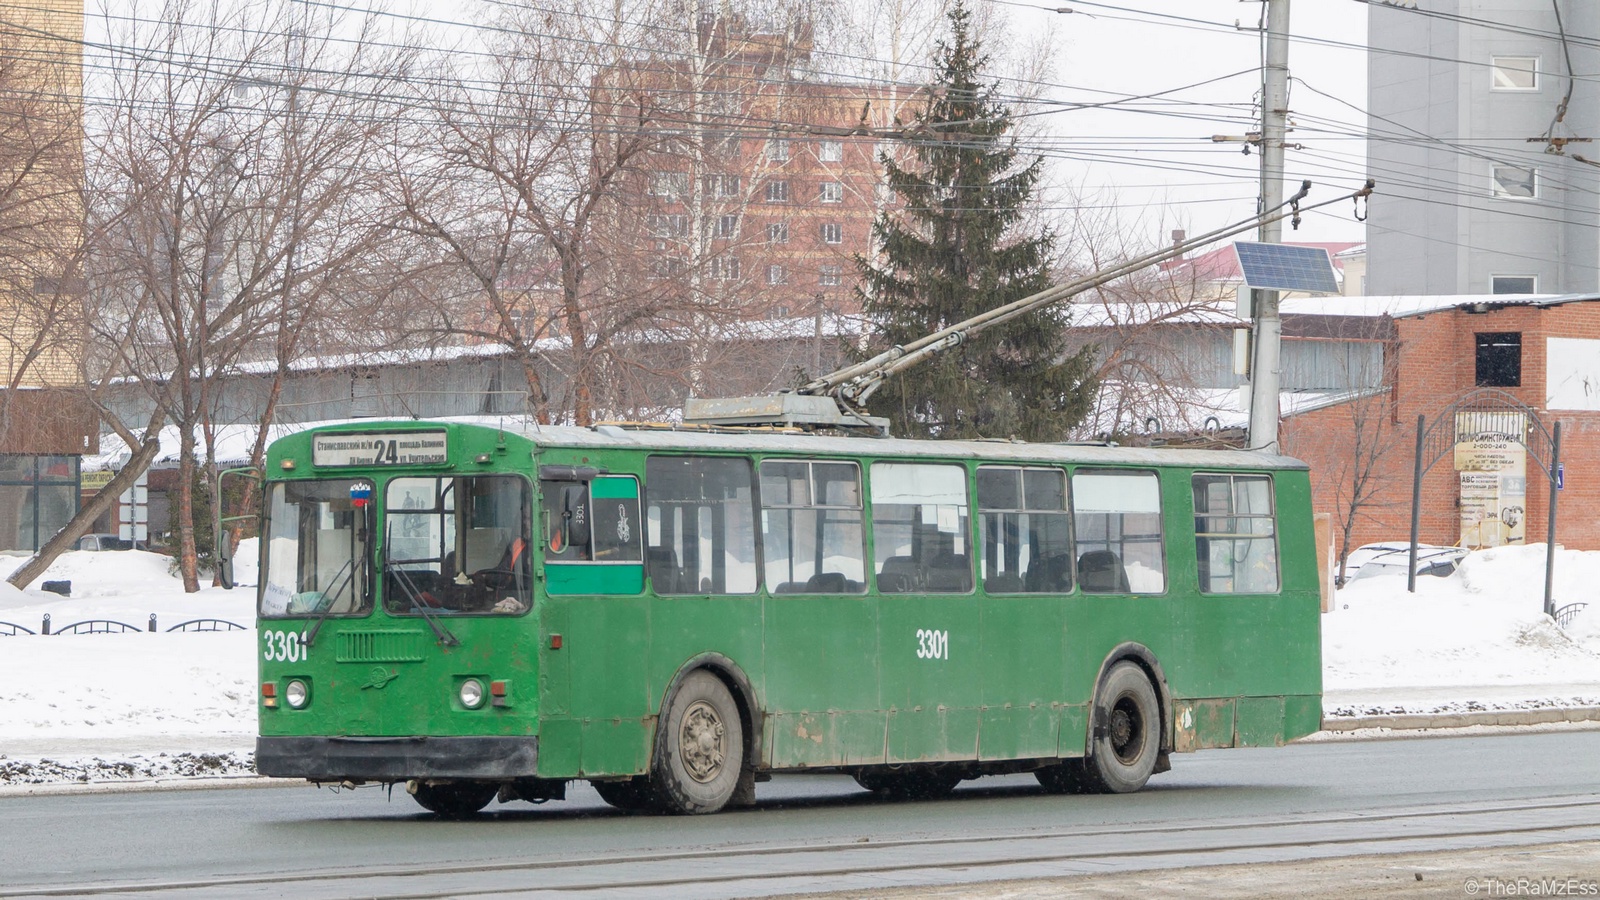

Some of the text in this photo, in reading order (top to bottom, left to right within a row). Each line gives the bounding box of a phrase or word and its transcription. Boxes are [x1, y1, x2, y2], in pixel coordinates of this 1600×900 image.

[318, 439, 373, 451] Станиславский ж/м
[374, 440, 398, 465] 24
[400, 440, 444, 450] площадь Калинина
[408, 453, 445, 464] Учительская
[264, 629, 308, 663] 3301
[916, 629, 949, 660] 3301
